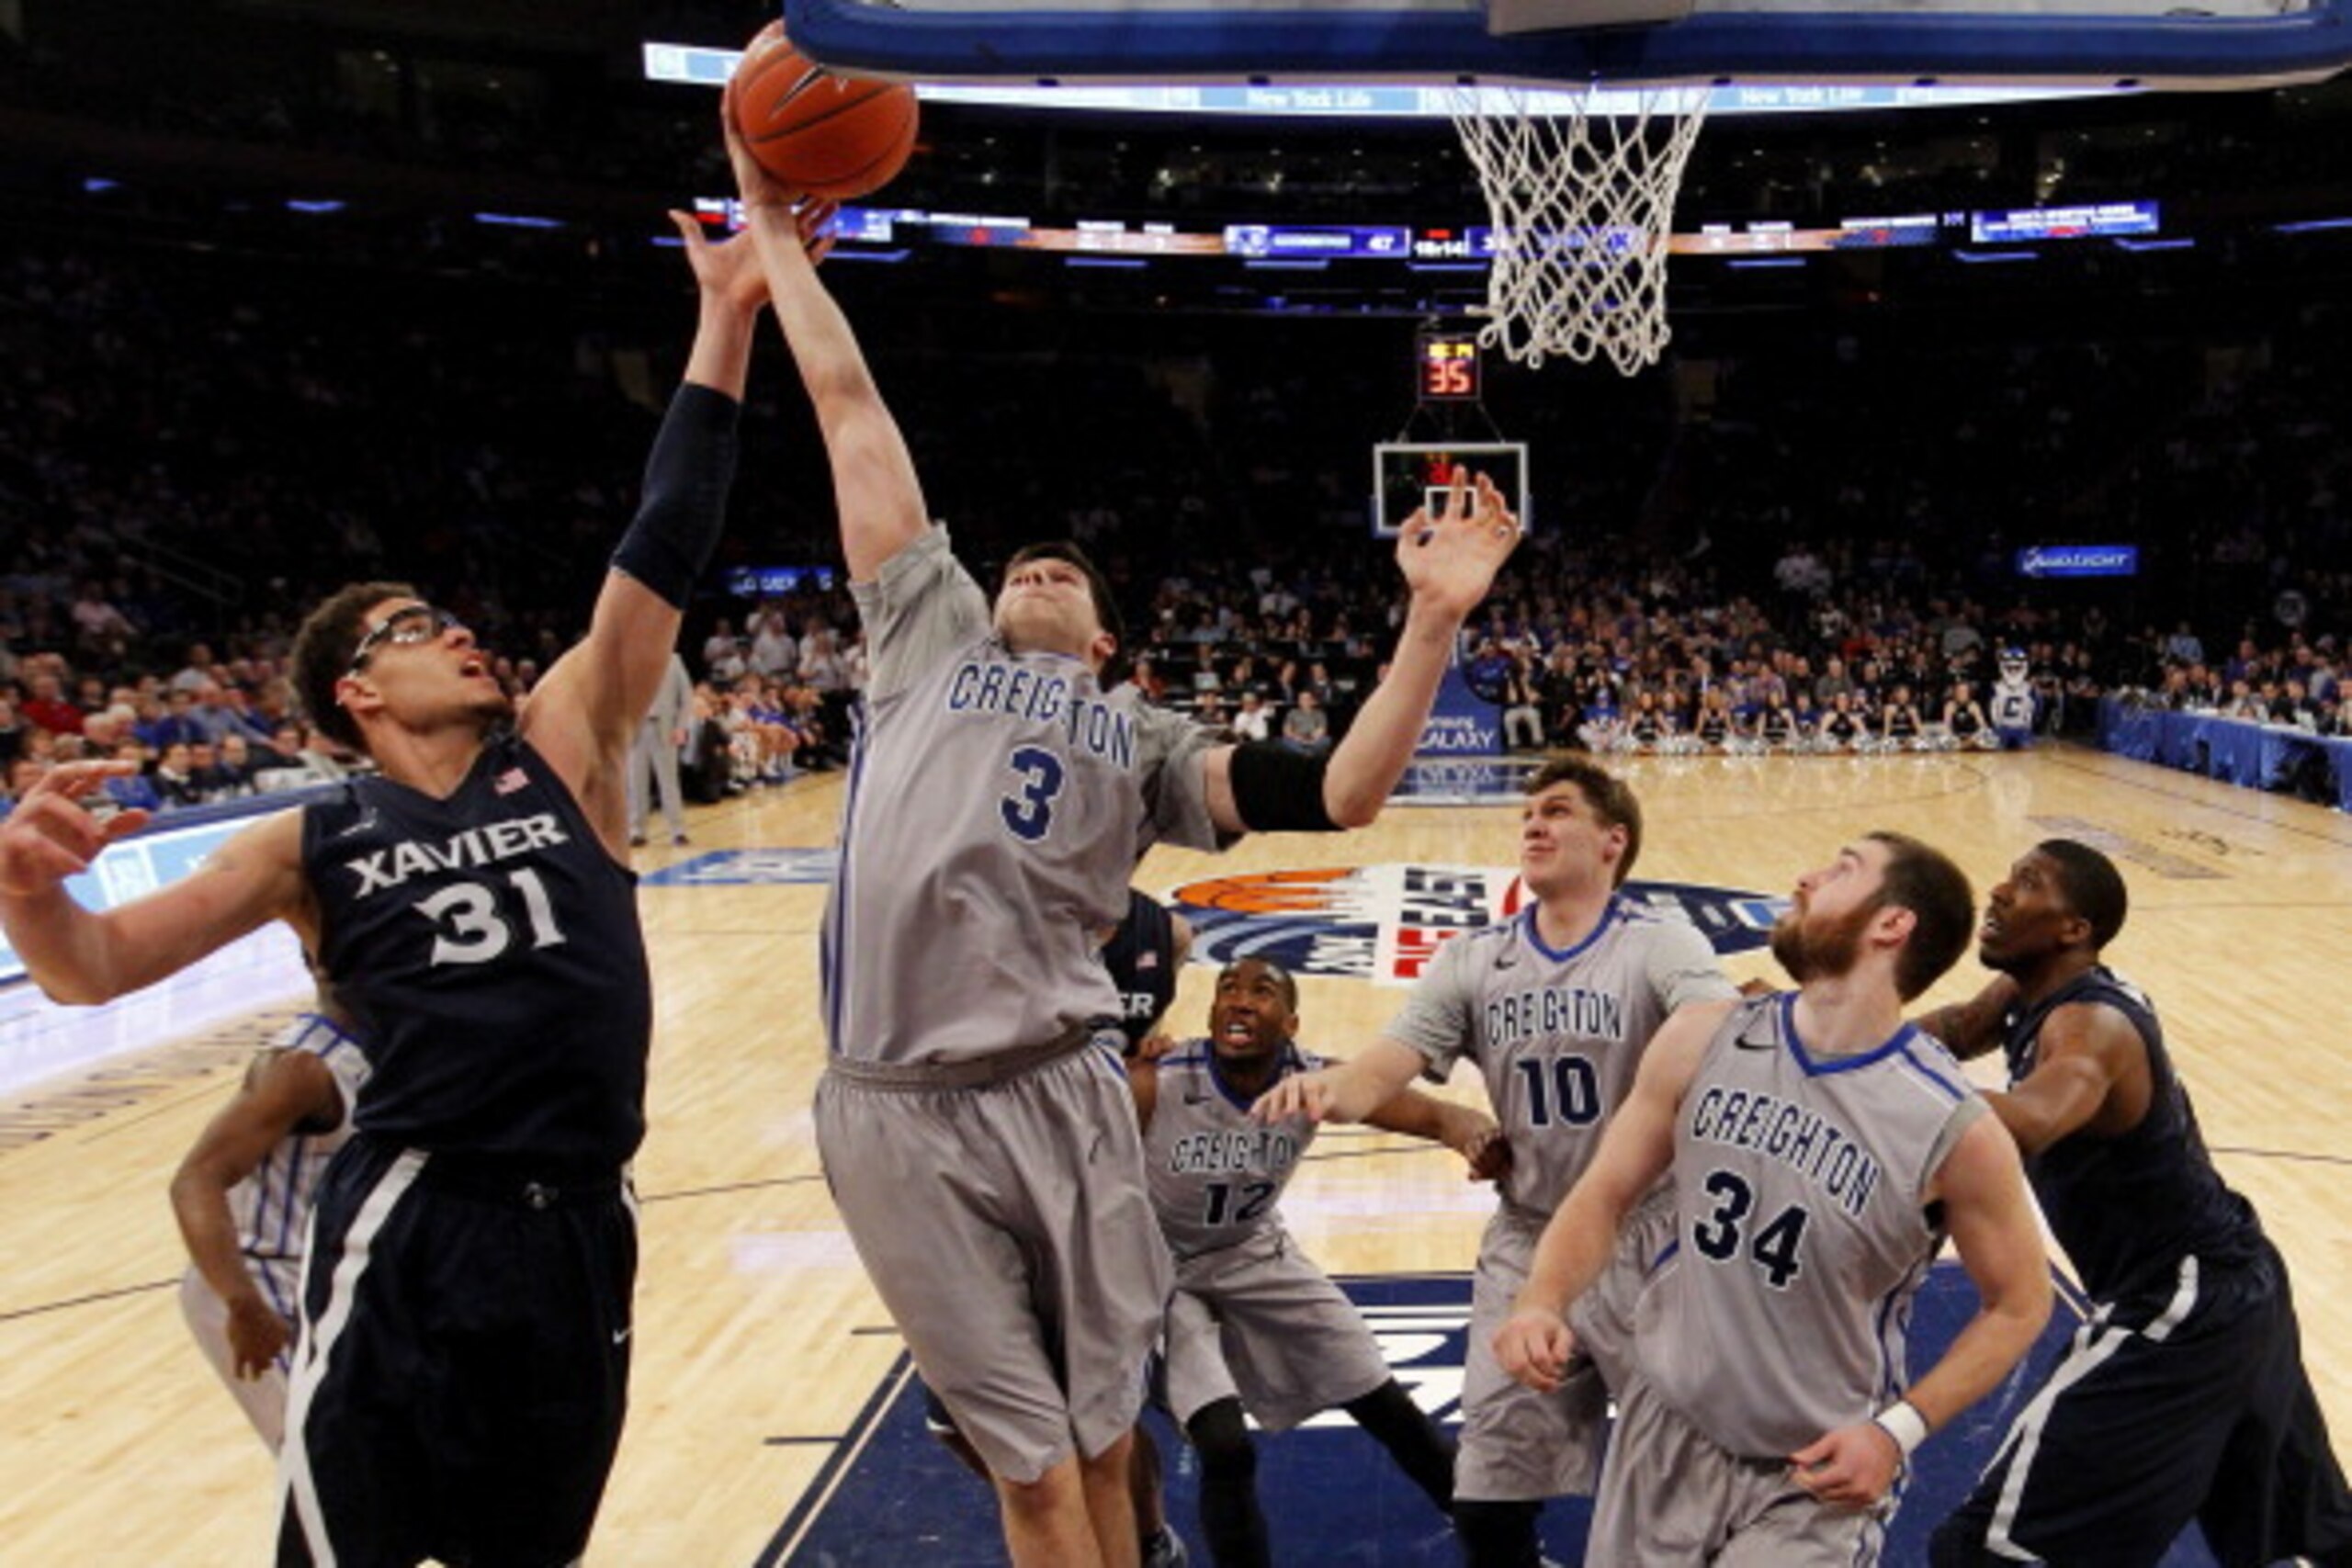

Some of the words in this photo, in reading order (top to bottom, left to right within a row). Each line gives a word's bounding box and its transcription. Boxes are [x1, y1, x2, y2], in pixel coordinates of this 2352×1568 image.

[1430, 359, 1470, 393] 35
[1001, 746, 1062, 841] 3
[344, 813, 570, 899] XAVIER
[412, 866, 567, 967] 31
[1487, 988, 1623, 1046] CREGHTON
[1516, 1056, 1602, 1126] 10
[1693, 1087, 1879, 1216] CREIGHTON
[1204, 1181, 1277, 1226] 12
[1693, 1169, 1809, 1288] 34
